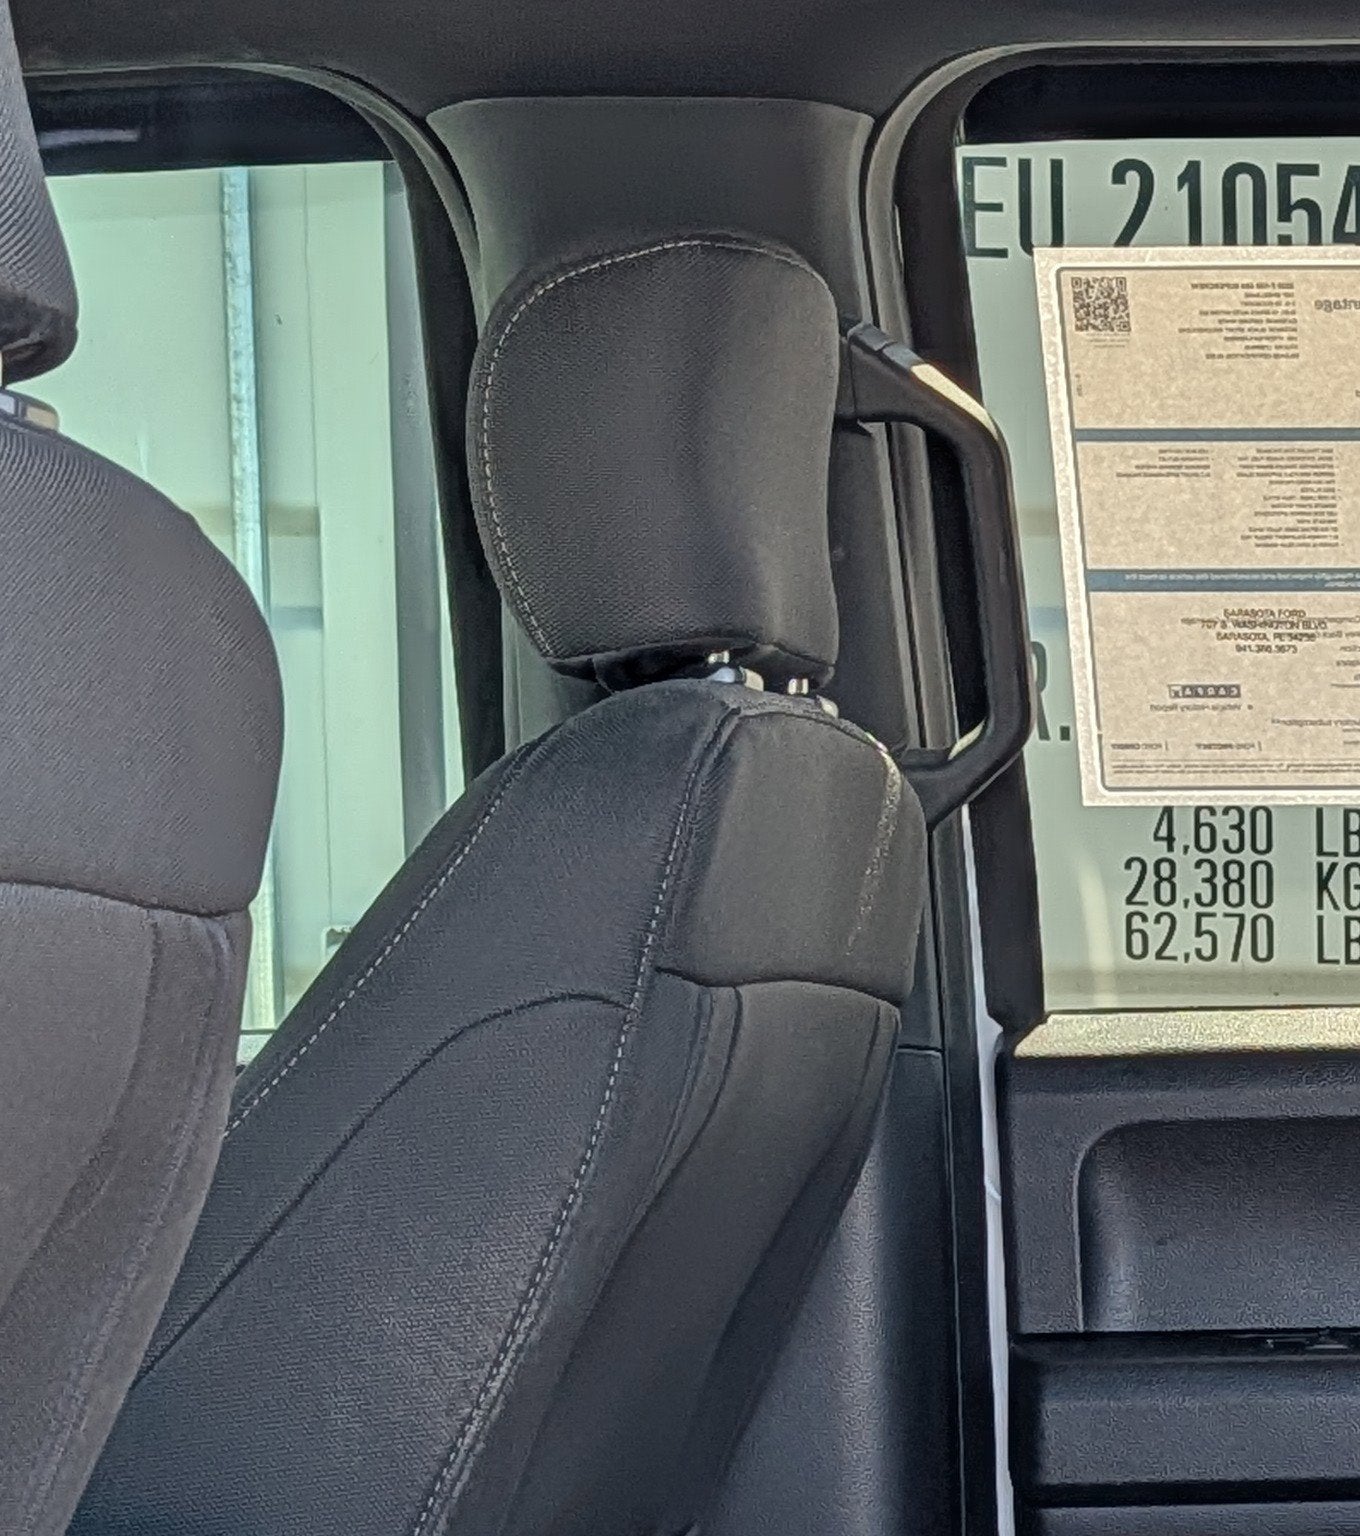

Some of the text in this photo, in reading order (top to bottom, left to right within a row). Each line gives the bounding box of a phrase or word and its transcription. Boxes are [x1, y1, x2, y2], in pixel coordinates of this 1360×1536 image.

[1153, 805, 1273, 855] 4,630
[1124, 856, 1274, 909] 28,380
[1125, 911, 1274, 963] 62,570
